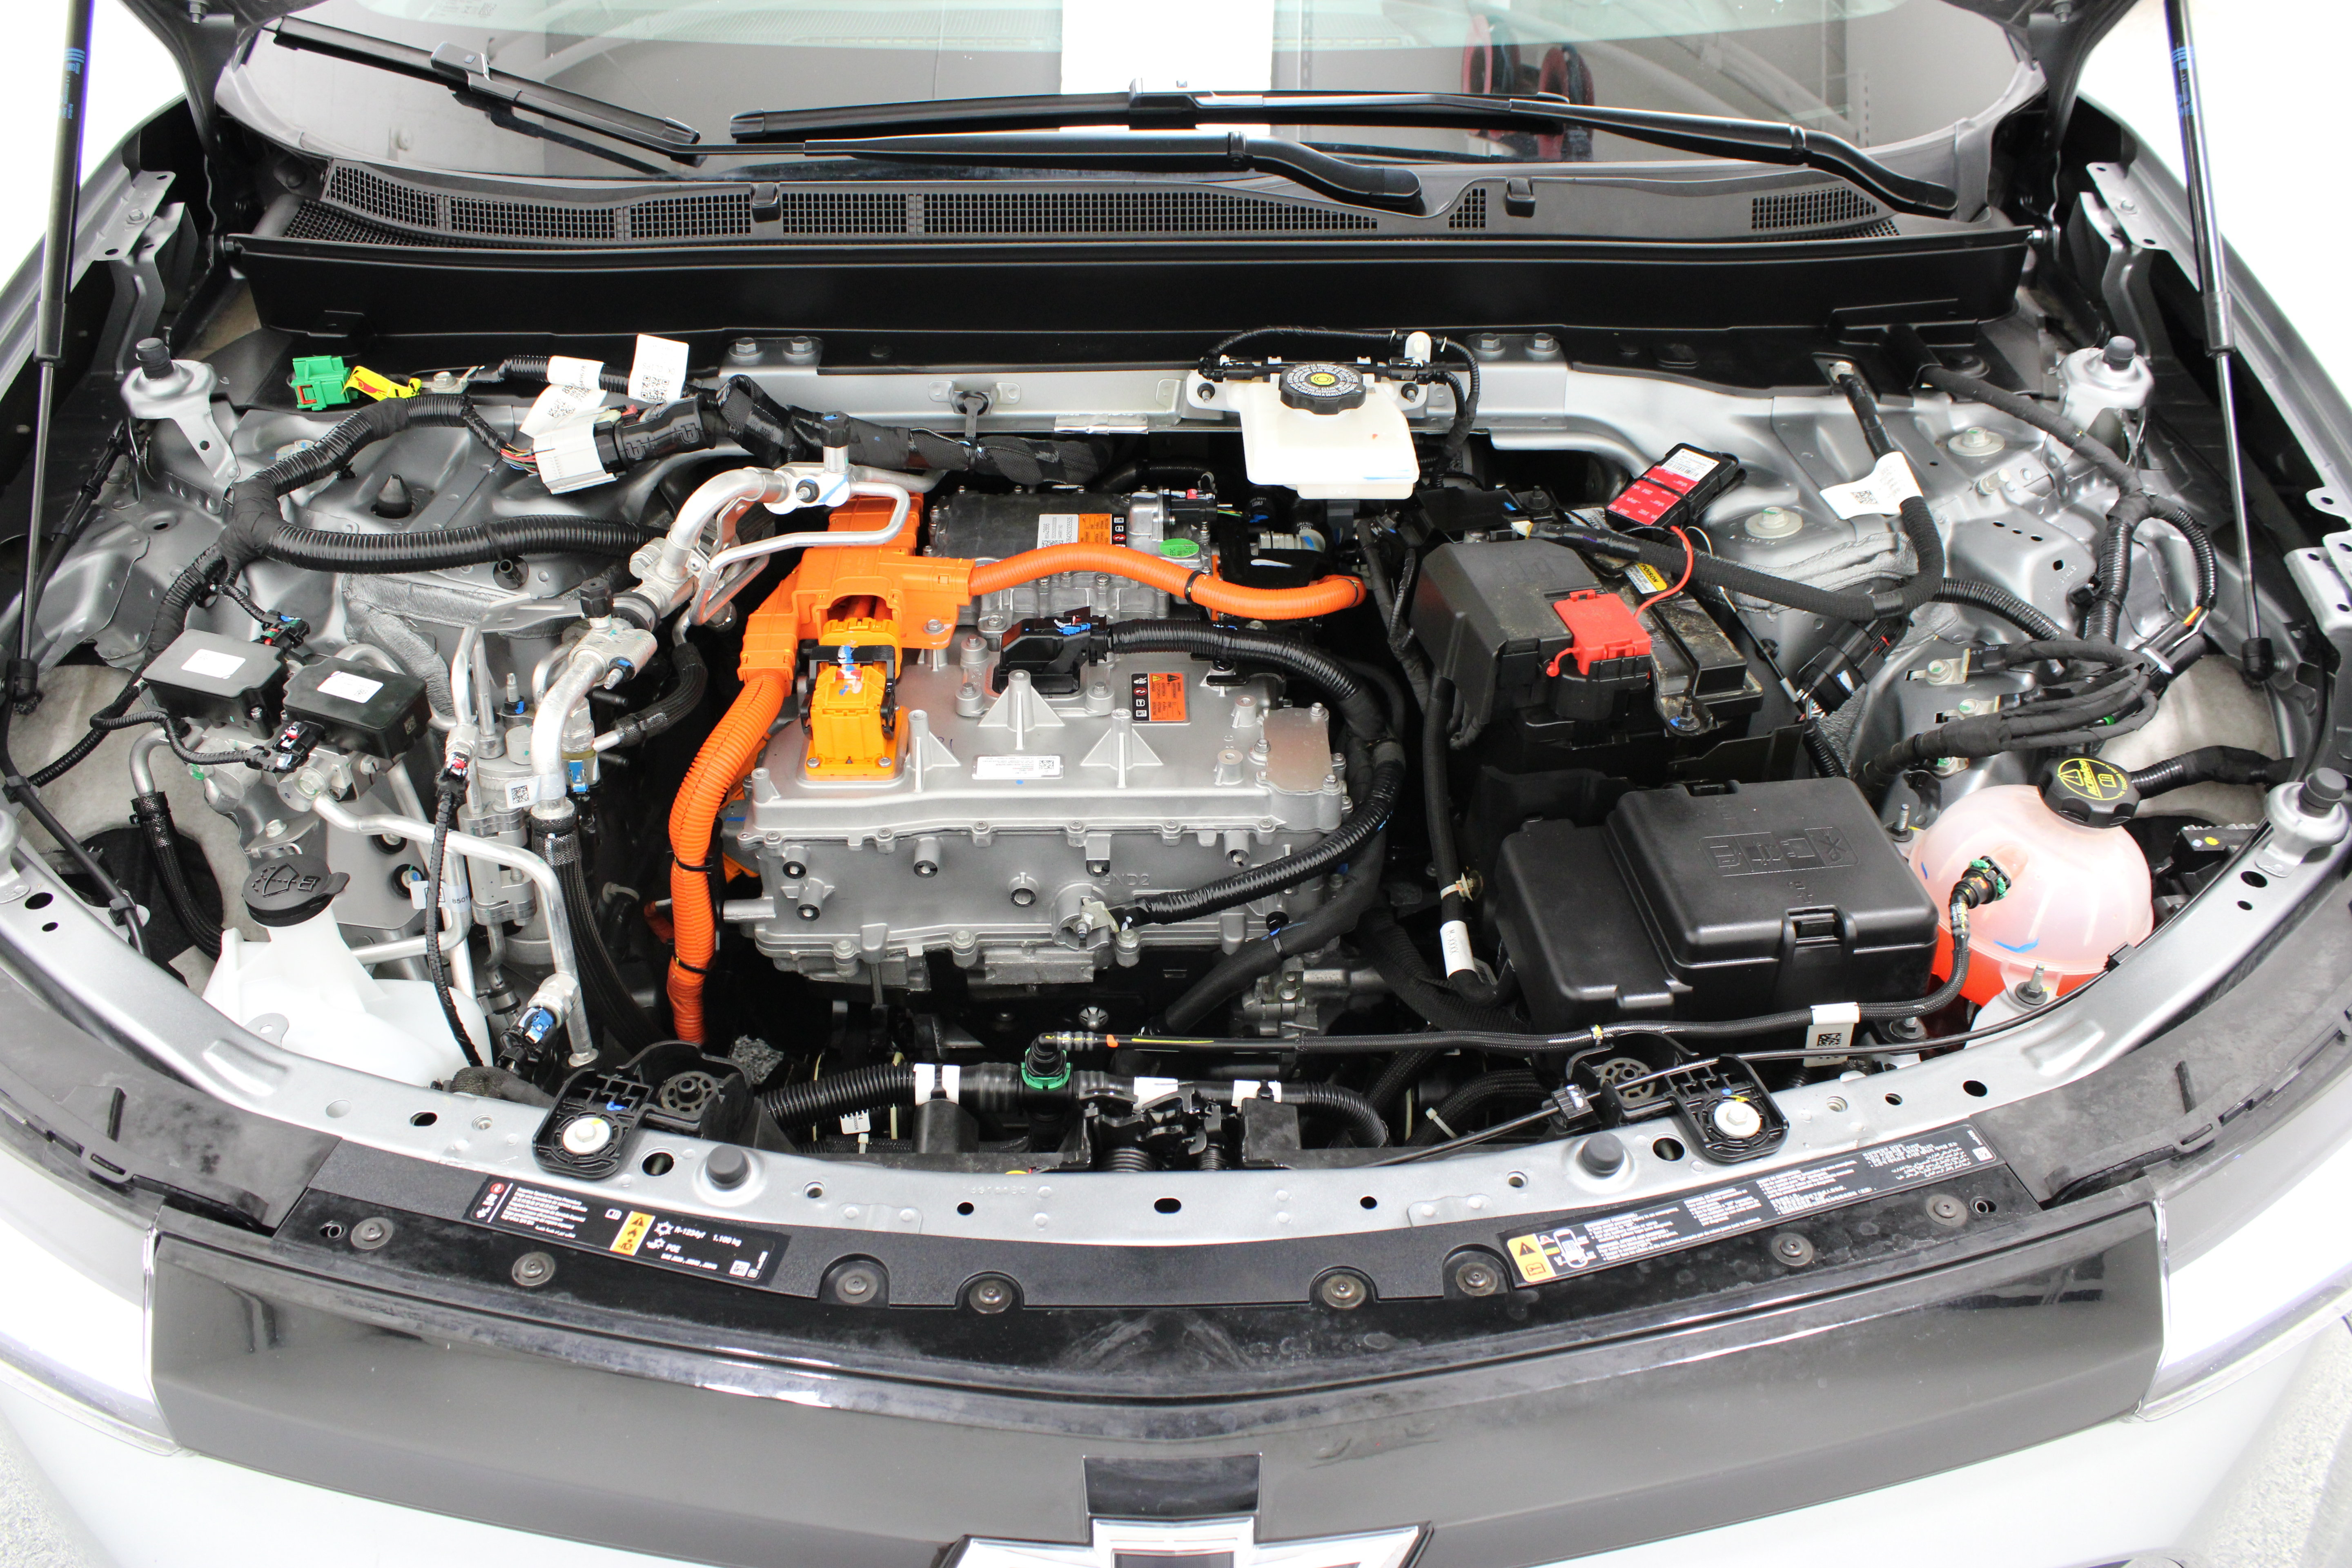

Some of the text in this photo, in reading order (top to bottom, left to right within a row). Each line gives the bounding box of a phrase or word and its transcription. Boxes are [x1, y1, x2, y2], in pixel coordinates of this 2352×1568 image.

[1641, 565, 1659, 583] POISON
[2078, 760, 2099, 797] ACDelco
[1096, 873, 1150, 887] GND2
[534, 1190, 548, 1198] Special
[674, 1226, 742, 1247] R-1234yf 1.100 kg
[665, 1243, 681, 1254] POE
